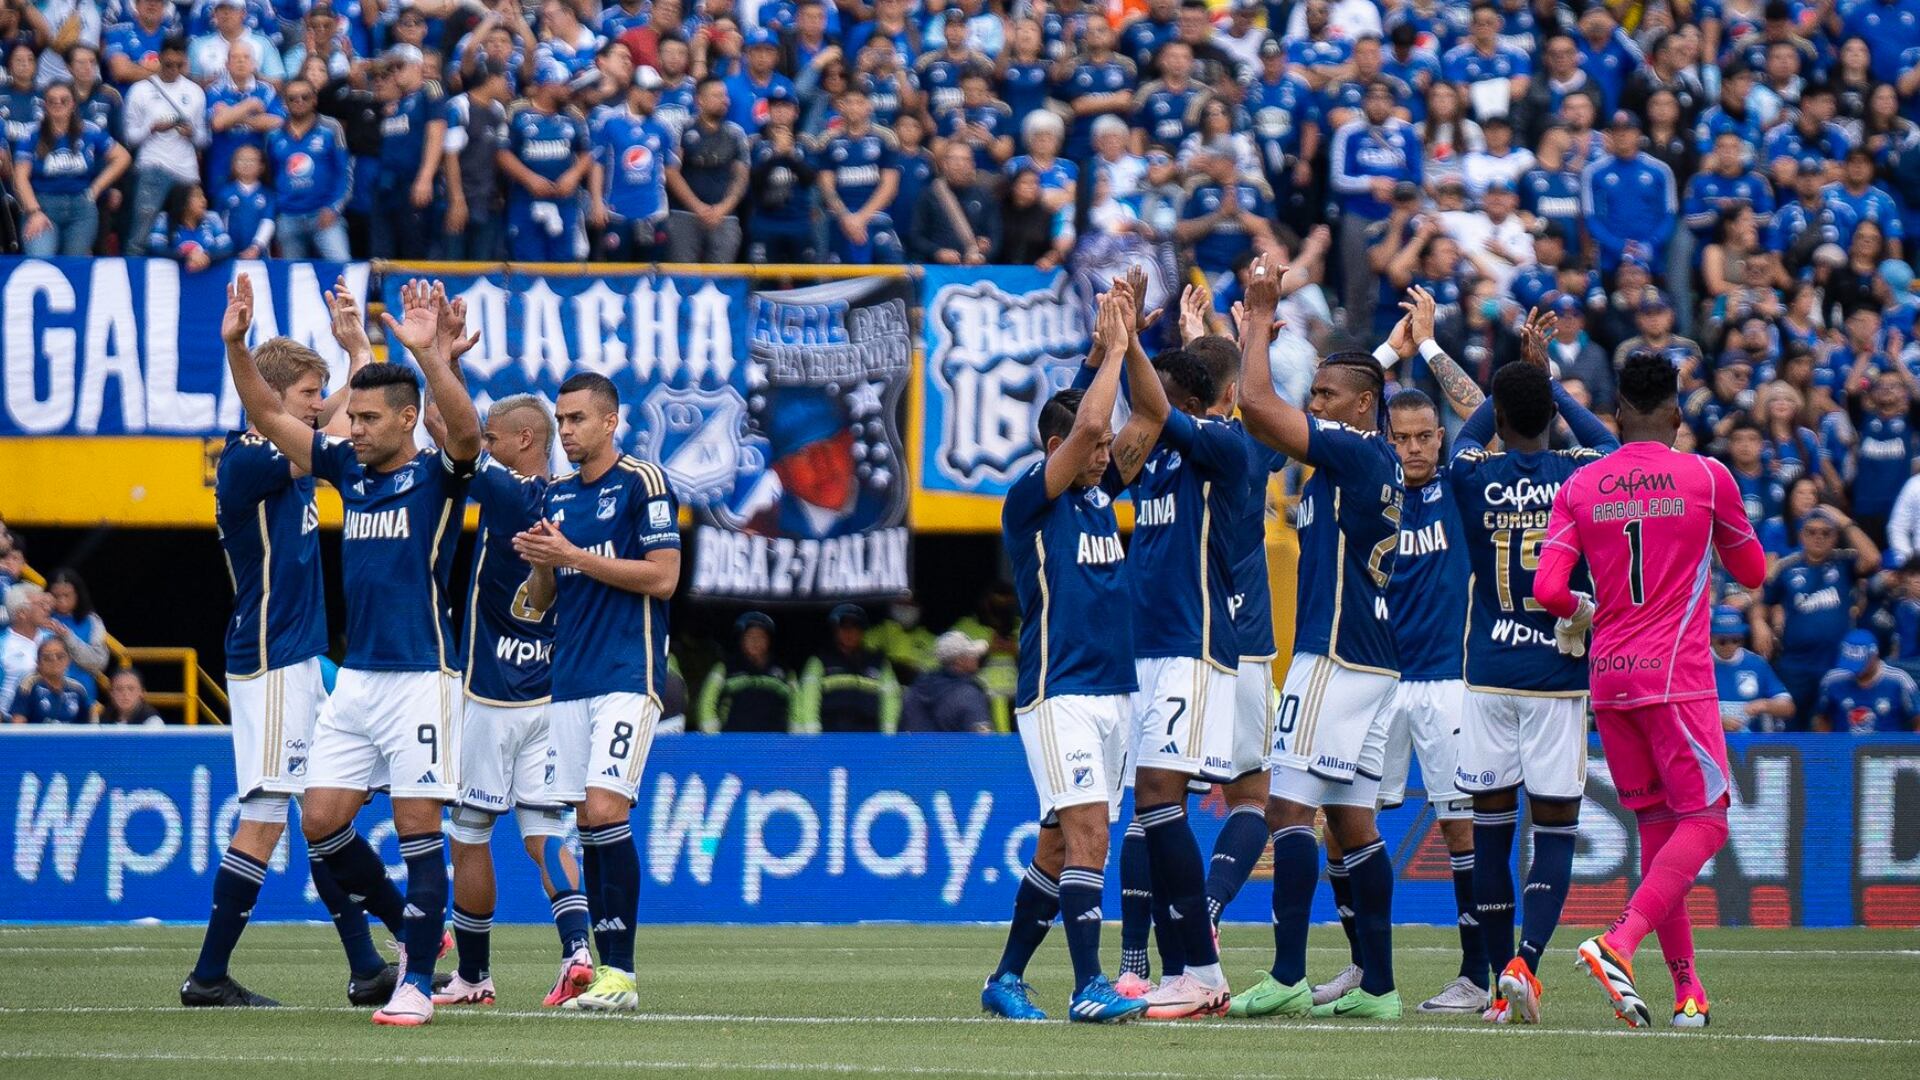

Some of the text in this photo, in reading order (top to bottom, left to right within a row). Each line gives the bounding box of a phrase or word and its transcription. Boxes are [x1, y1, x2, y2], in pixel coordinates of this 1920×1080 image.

[404, 276, 737, 386] OACHA
[1593, 498, 1685, 523] ARBOLEDA
[1622, 518, 1645, 606] 1
[1166, 697, 1187, 735] 7
[416, 724, 437, 764] 9
[608, 720, 633, 760] 8
[468, 787, 504, 805] Allianz
[647, 766, 1048, 906] Wplay.c
